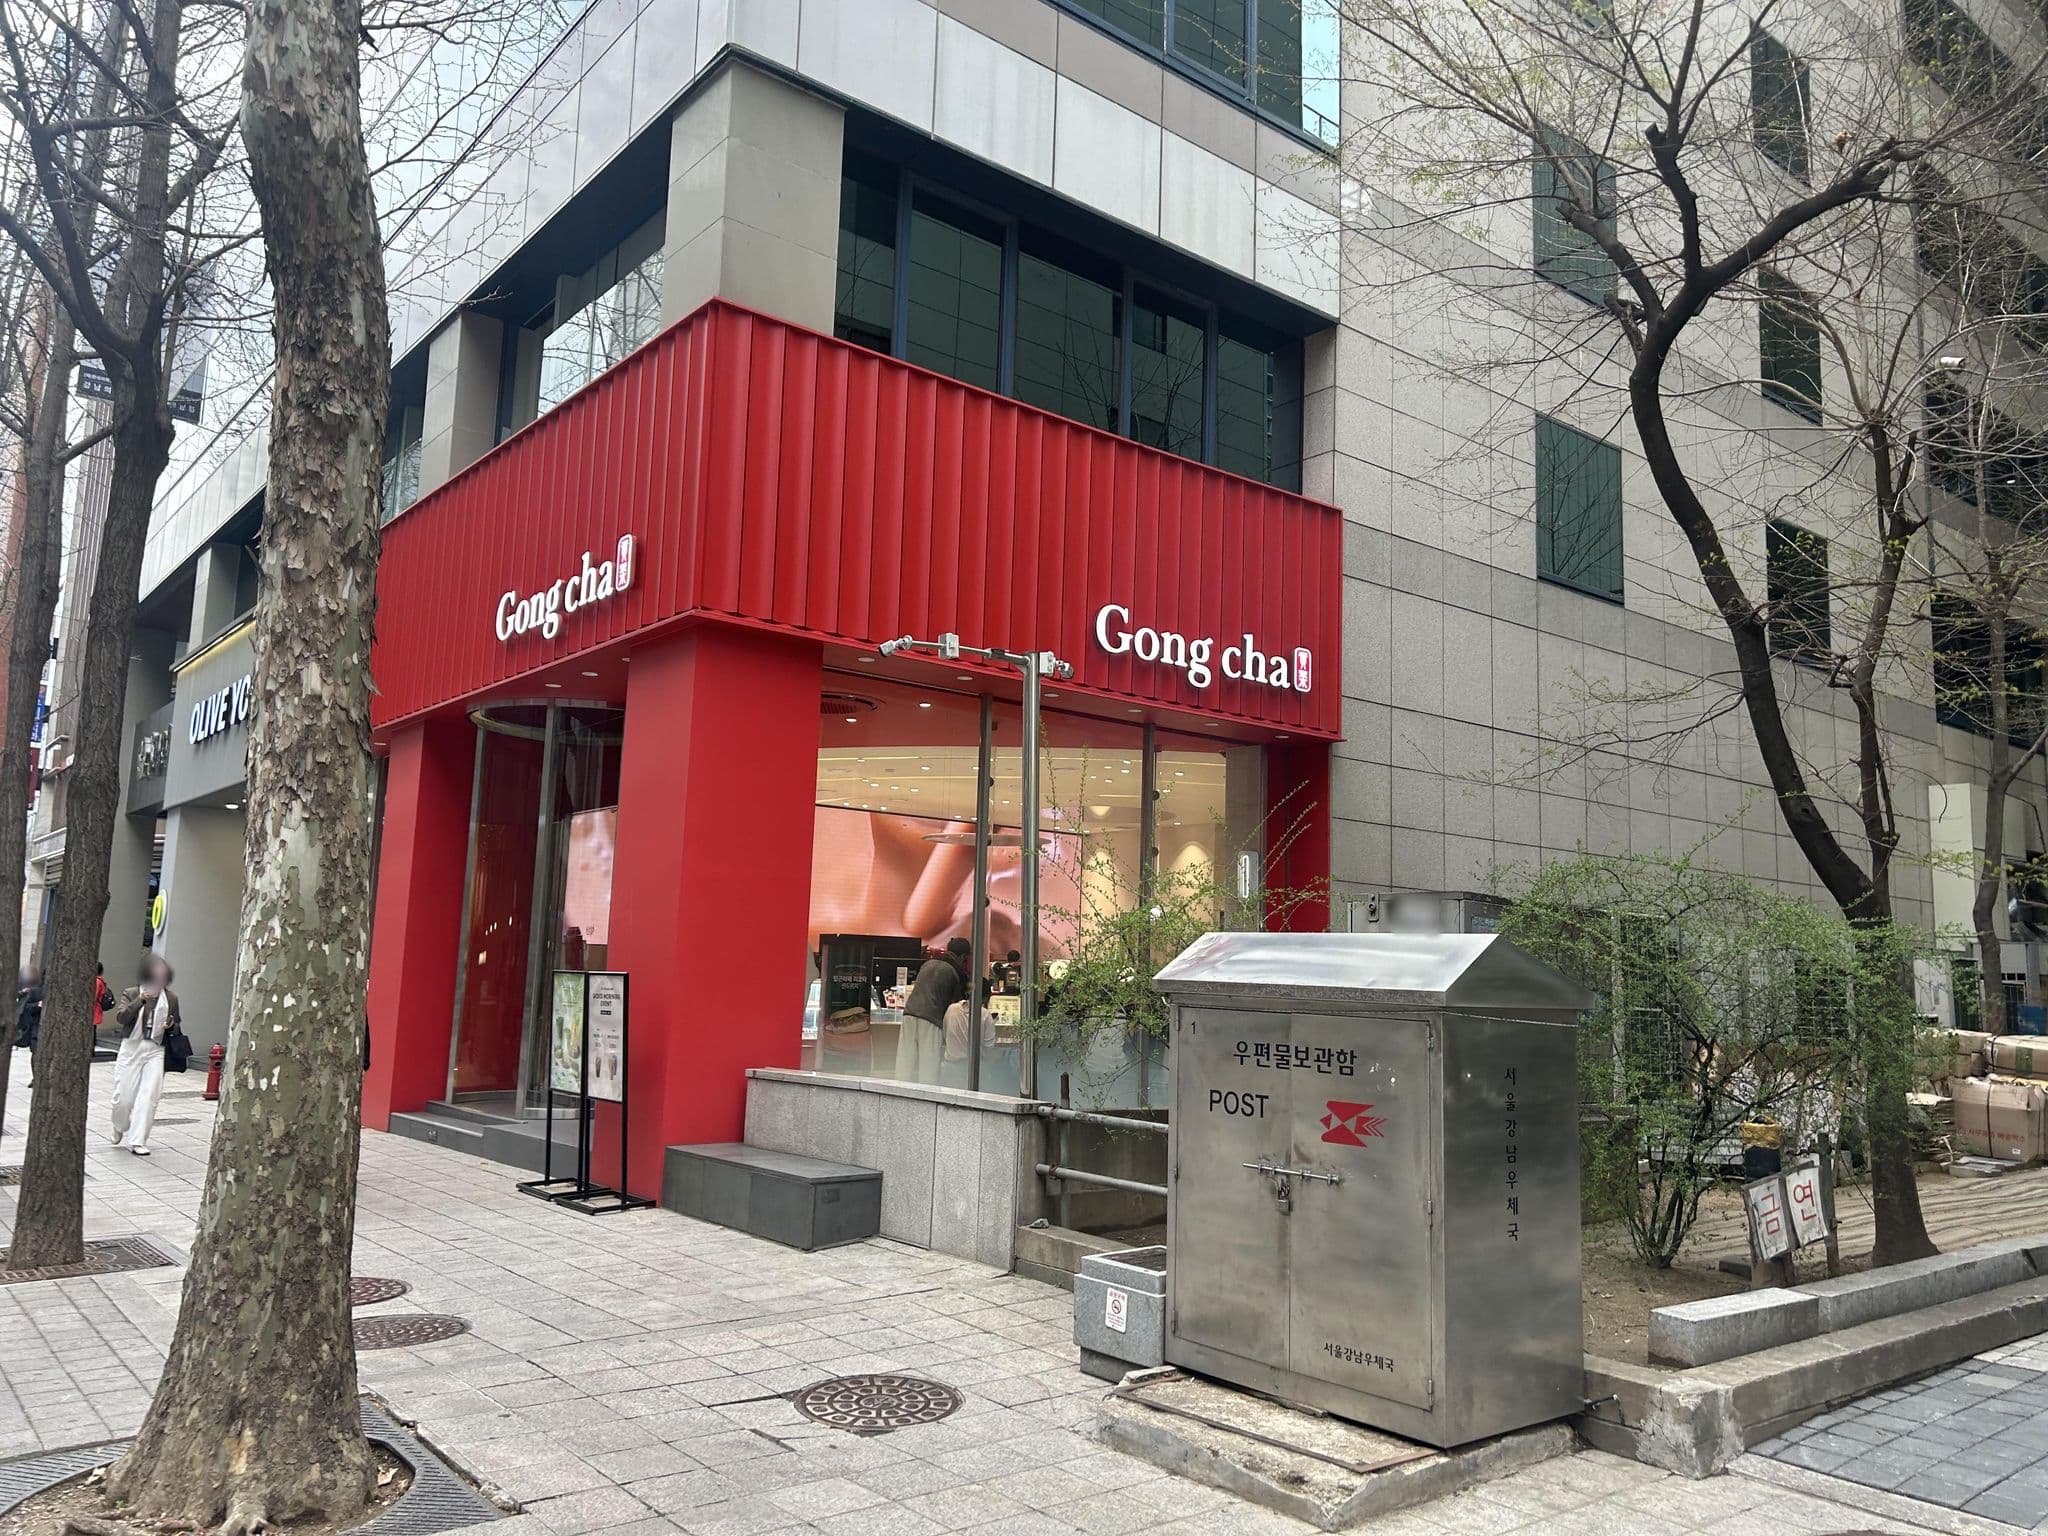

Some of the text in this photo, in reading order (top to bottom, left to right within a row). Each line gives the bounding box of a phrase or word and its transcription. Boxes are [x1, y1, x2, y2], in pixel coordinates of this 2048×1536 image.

[495, 551, 613, 641] Gong cha
[1096, 604, 1291, 689] Gong cha
[189, 674, 251, 745] OLIVE YO
[1191, 1020, 1196, 1035] 1
[1233, 1040, 1358, 1076] 우편물보관함
[1209, 1088, 1270, 1119] POST
[1504, 1067, 1520, 1241] 서울강남우체국
[1323, 1342, 1394, 1373] 서울강남우체국
